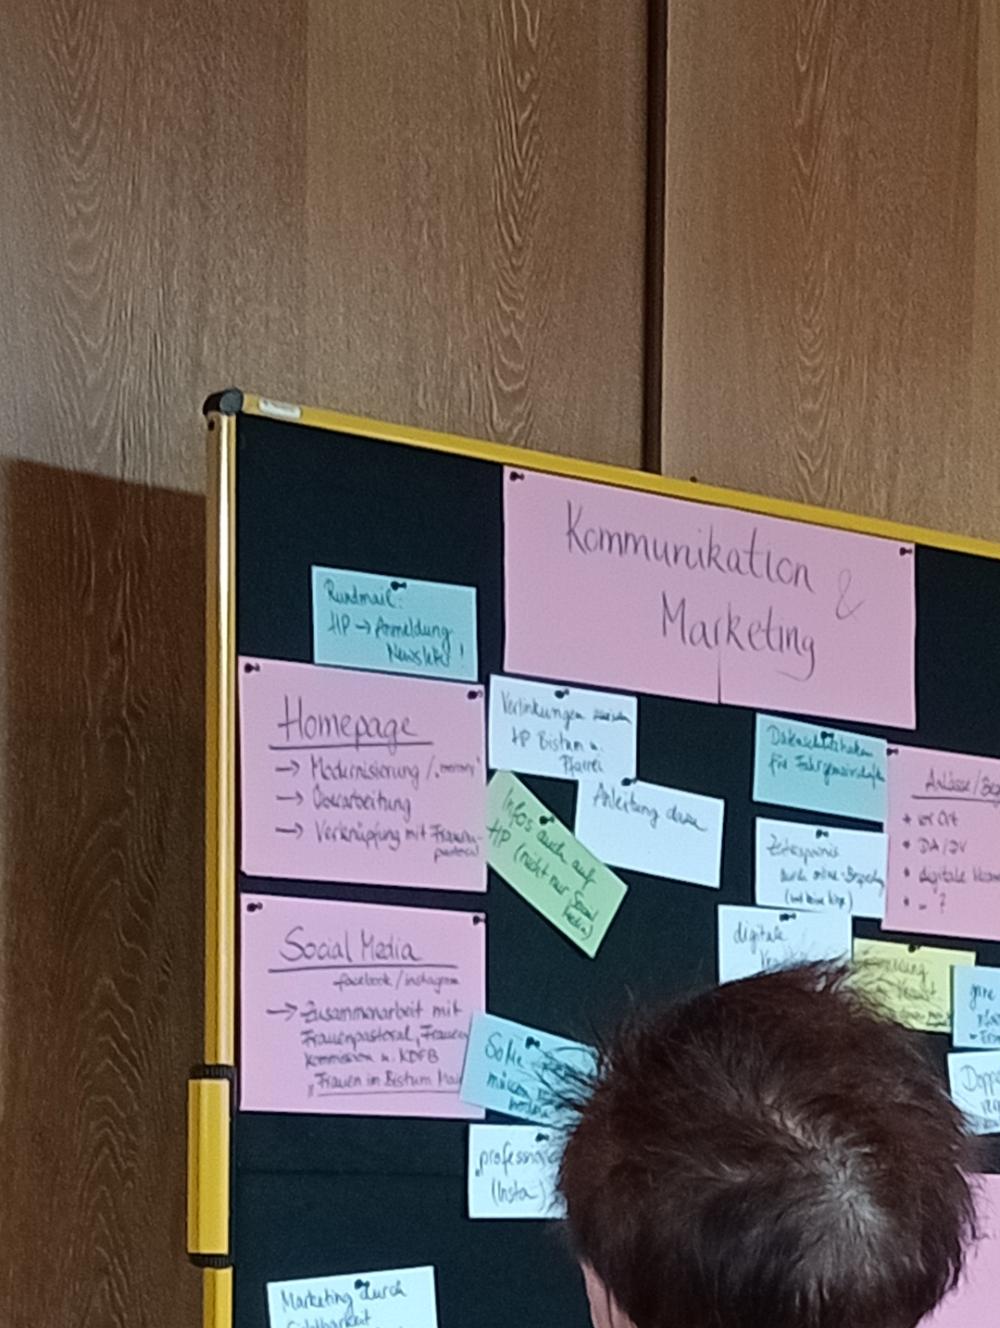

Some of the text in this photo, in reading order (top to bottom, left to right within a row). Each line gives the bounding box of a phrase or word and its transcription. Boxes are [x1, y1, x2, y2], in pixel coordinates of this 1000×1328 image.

[566, 499, 867, 620] Kommunikation &
[661, 589, 816, 680] Marketing
[277, 694, 418, 756] Homepage
[310, 753, 420, 790] Modernisierung
[405, 822, 426, 842] mit
[503, 786, 534, 833] Infos
[536, 829, 567, 865] auch
[279, 925, 422, 963] Social Media
[300, 998, 463, 1023] Zusammenarbeit mit
[281, 1280, 407, 1315] Marketing durch
